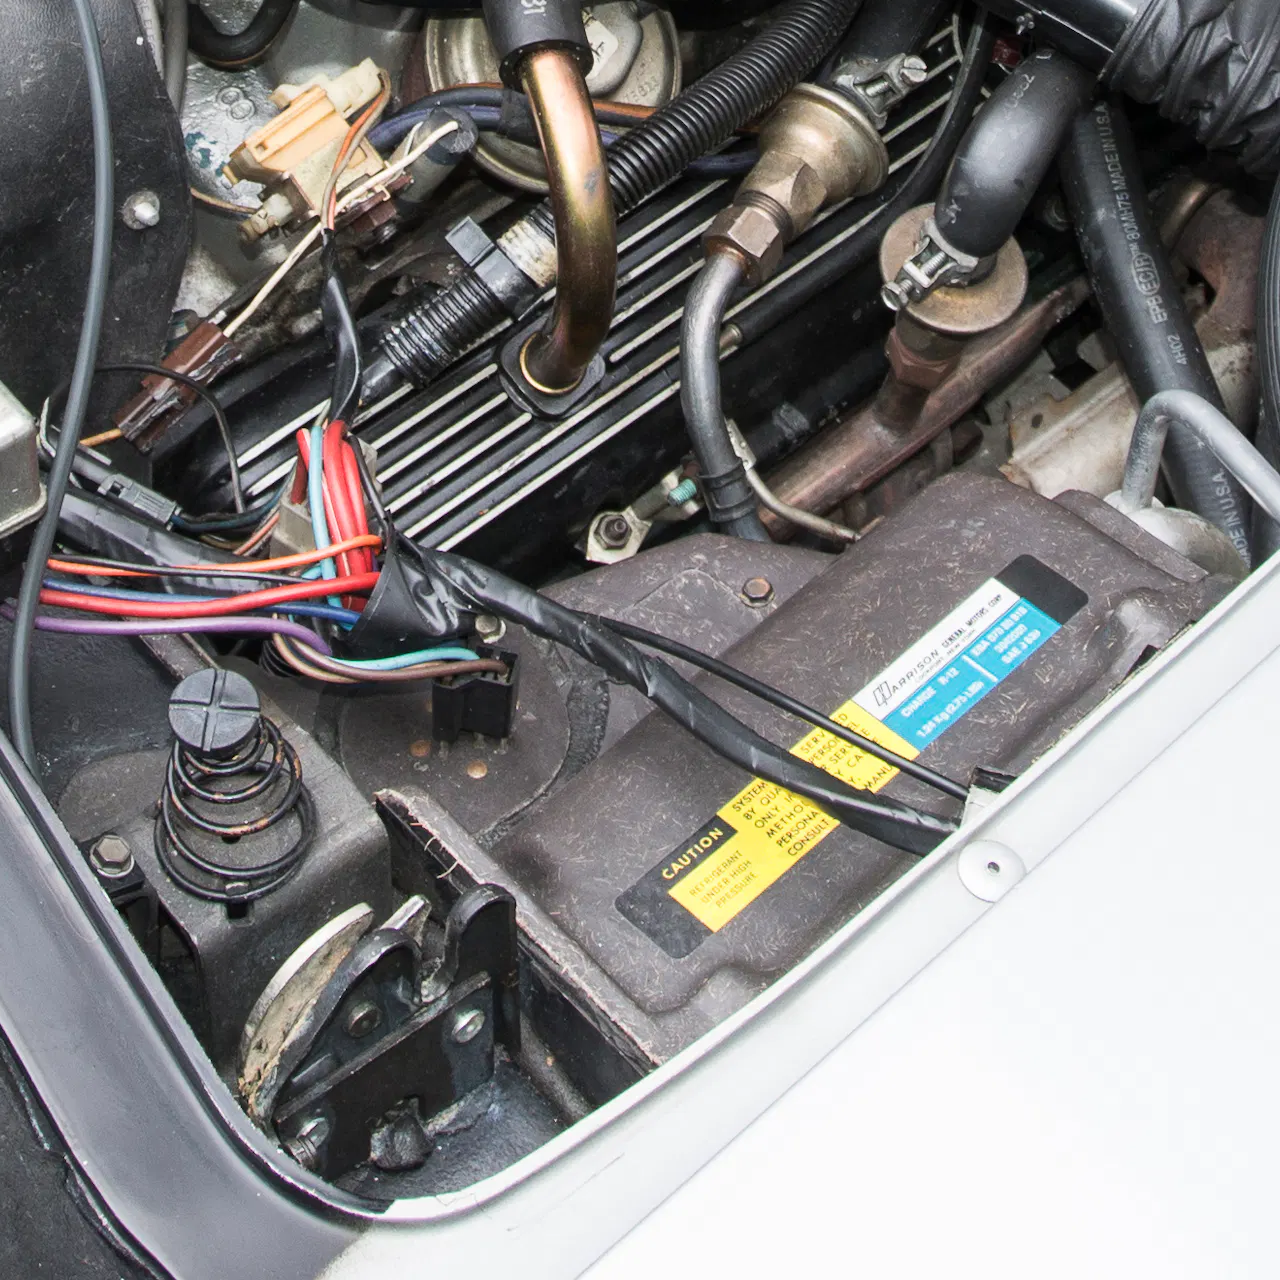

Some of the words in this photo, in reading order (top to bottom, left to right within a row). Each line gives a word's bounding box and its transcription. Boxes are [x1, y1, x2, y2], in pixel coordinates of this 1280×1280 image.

[1102, 135, 1117, 152] IN
[1104, 152, 1129, 192] MADE
[1222, 509, 1242, 527] IN
[941, 627, 966, 648] GENERAL
[965, 608, 989, 627] MOTORS
[732, 781, 769, 813] SYSTEM
[742, 807, 758, 821] BY
[766, 799, 810, 839] METHO
[776, 809, 820, 848] PERSONA
[787, 818, 831, 856] CONSULT
[661, 827, 724, 880] CAUTION
[688, 849, 743, 897] REFRIGERANT
[700, 877, 731, 904] UNDER
[730, 859, 752, 880] HIGH
[715, 871, 759, 909] PRESSURE
